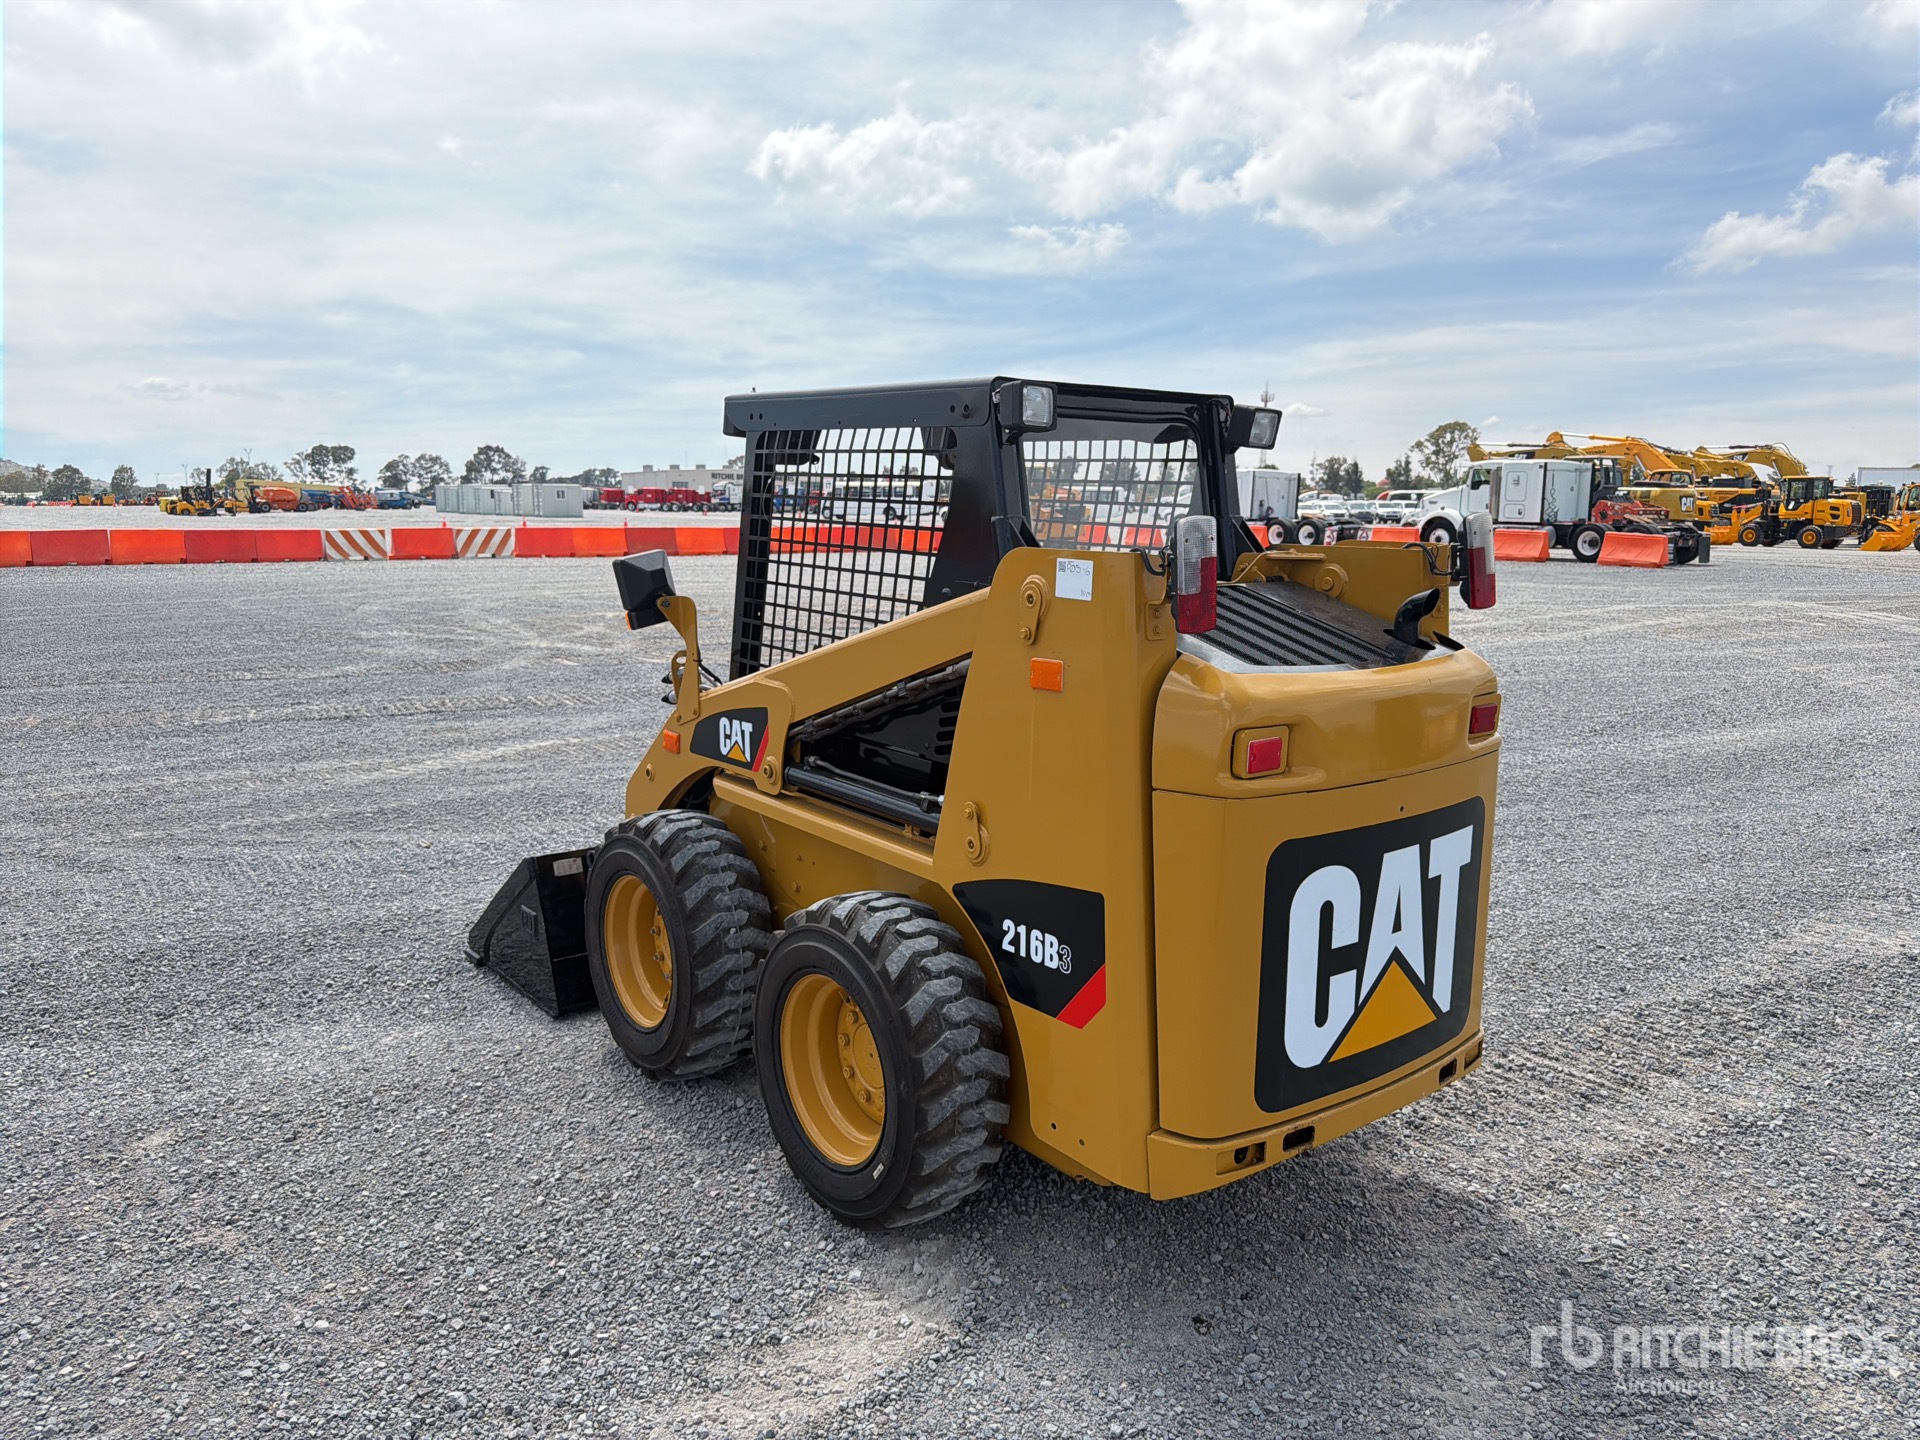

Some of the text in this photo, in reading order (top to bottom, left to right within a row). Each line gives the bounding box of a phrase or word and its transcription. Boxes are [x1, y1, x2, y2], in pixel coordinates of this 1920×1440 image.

[1681, 496, 1694, 512] CAT
[719, 716, 753, 763] CAT
[1284, 824, 1474, 1068] CAT
